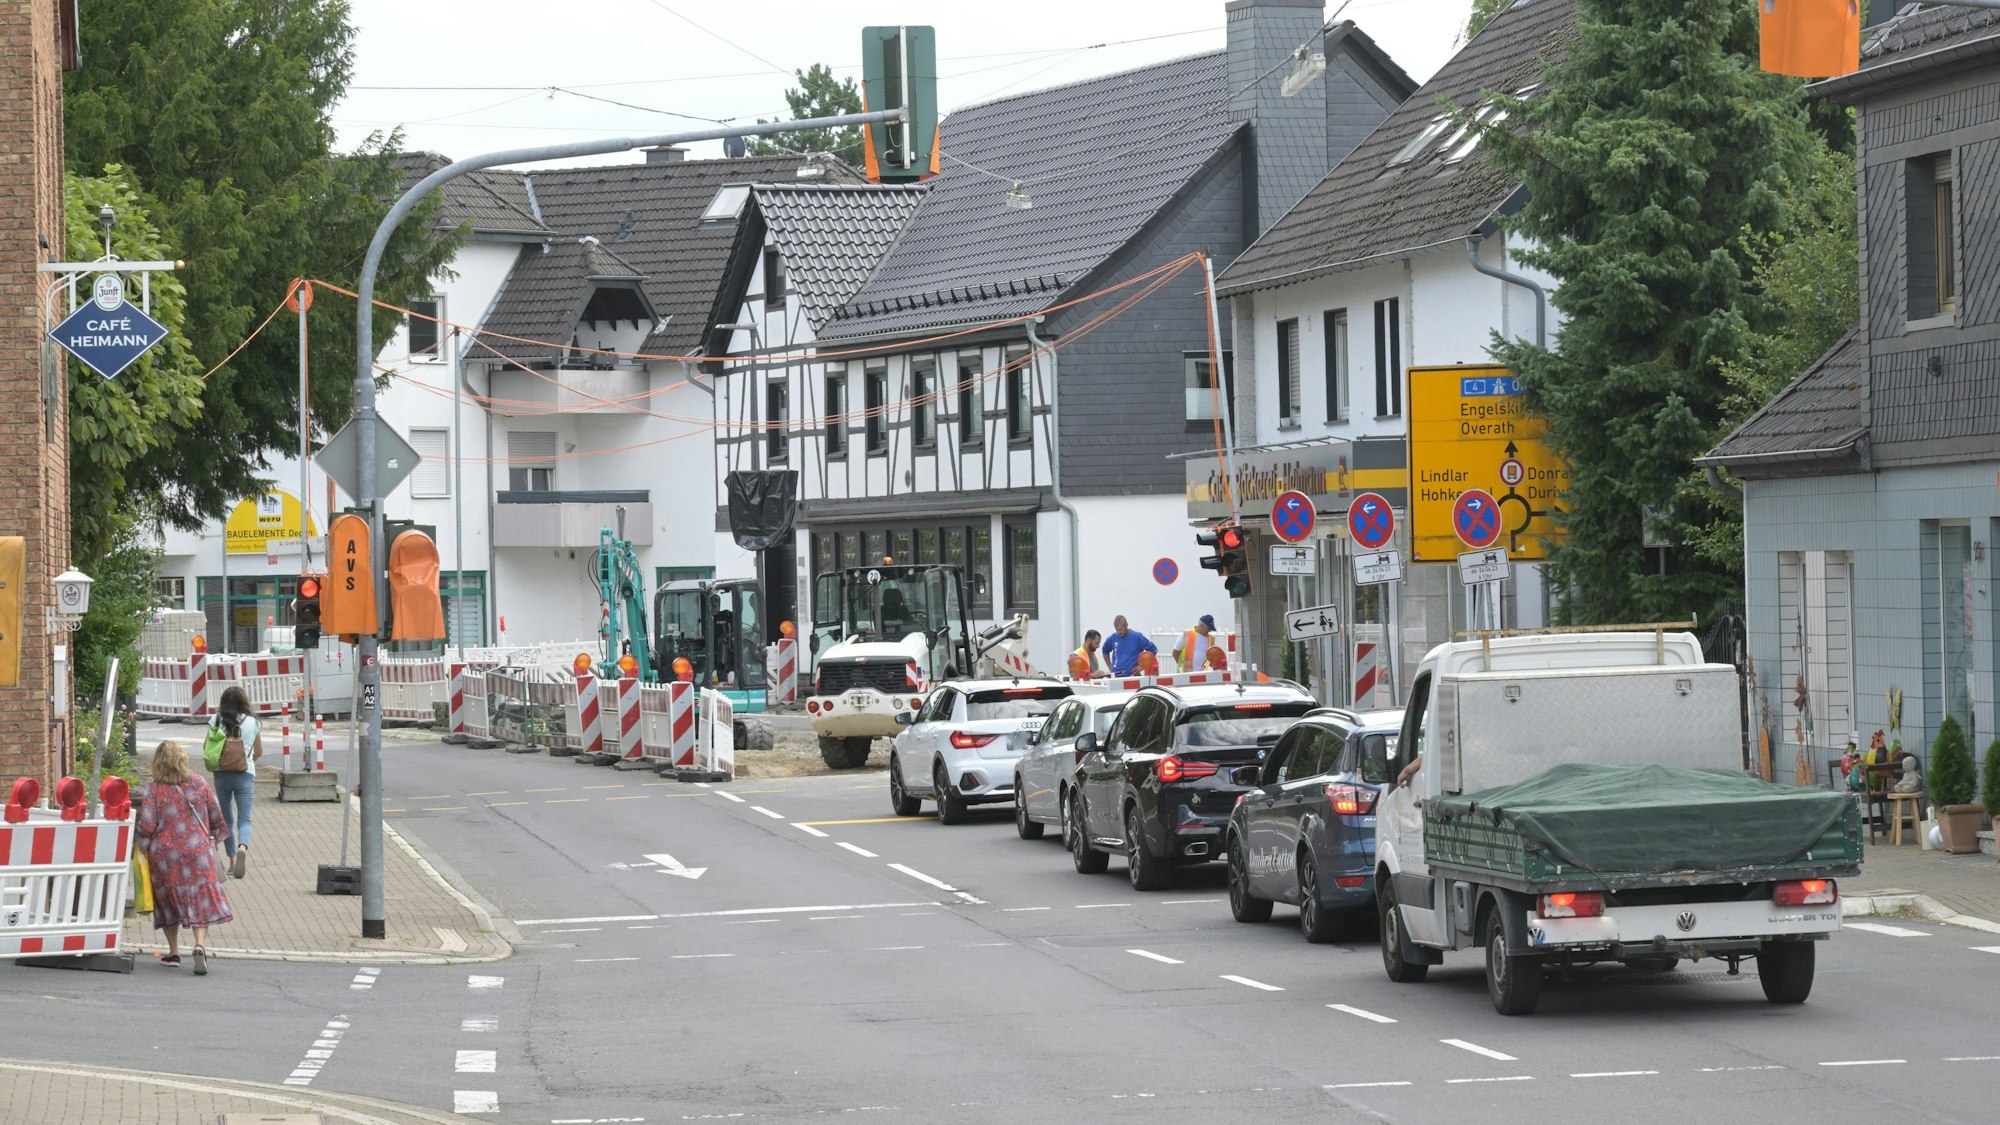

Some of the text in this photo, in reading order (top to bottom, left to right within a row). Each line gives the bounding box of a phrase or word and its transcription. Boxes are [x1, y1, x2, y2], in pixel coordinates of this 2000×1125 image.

[86, 316, 131, 331] CAFÉ
[70, 335, 148, 347] HEIMANN
[1472, 382, 1478, 391] 4
[1461, 402, 1520, 418] Engelski
[1461, 421, 1515, 435] Overath
[1421, 469, 1469, 482] Lindlar
[1528, 467, 1571, 480] Donra
[259, 515, 281, 523] weru
[227, 529, 285, 538] BAUELEMENTE
[364, 685, 375, 694] A1
[364, 696, 375, 704] A2
